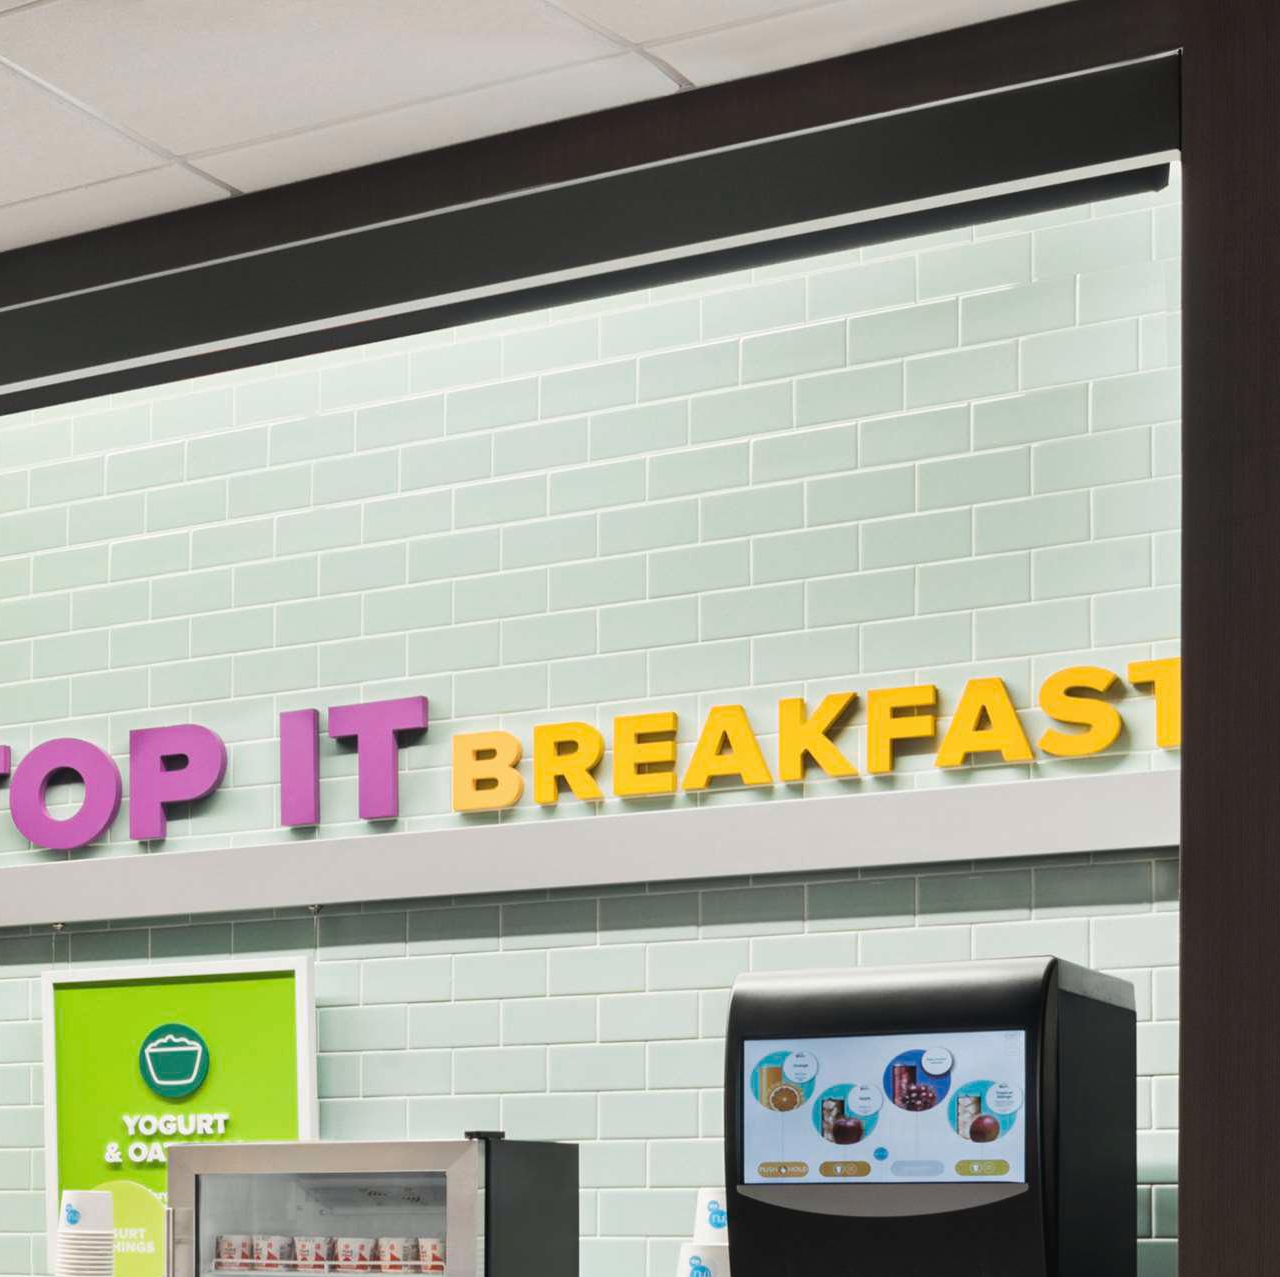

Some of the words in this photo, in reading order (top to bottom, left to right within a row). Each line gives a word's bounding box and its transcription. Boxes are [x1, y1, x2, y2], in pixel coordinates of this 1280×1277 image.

[279, 694, 429, 827] IT
[451, 656, 1182, 813] BREAKFAST
[121, 1113, 229, 1136] YOGURT
[104, 1142, 122, 1162] &
